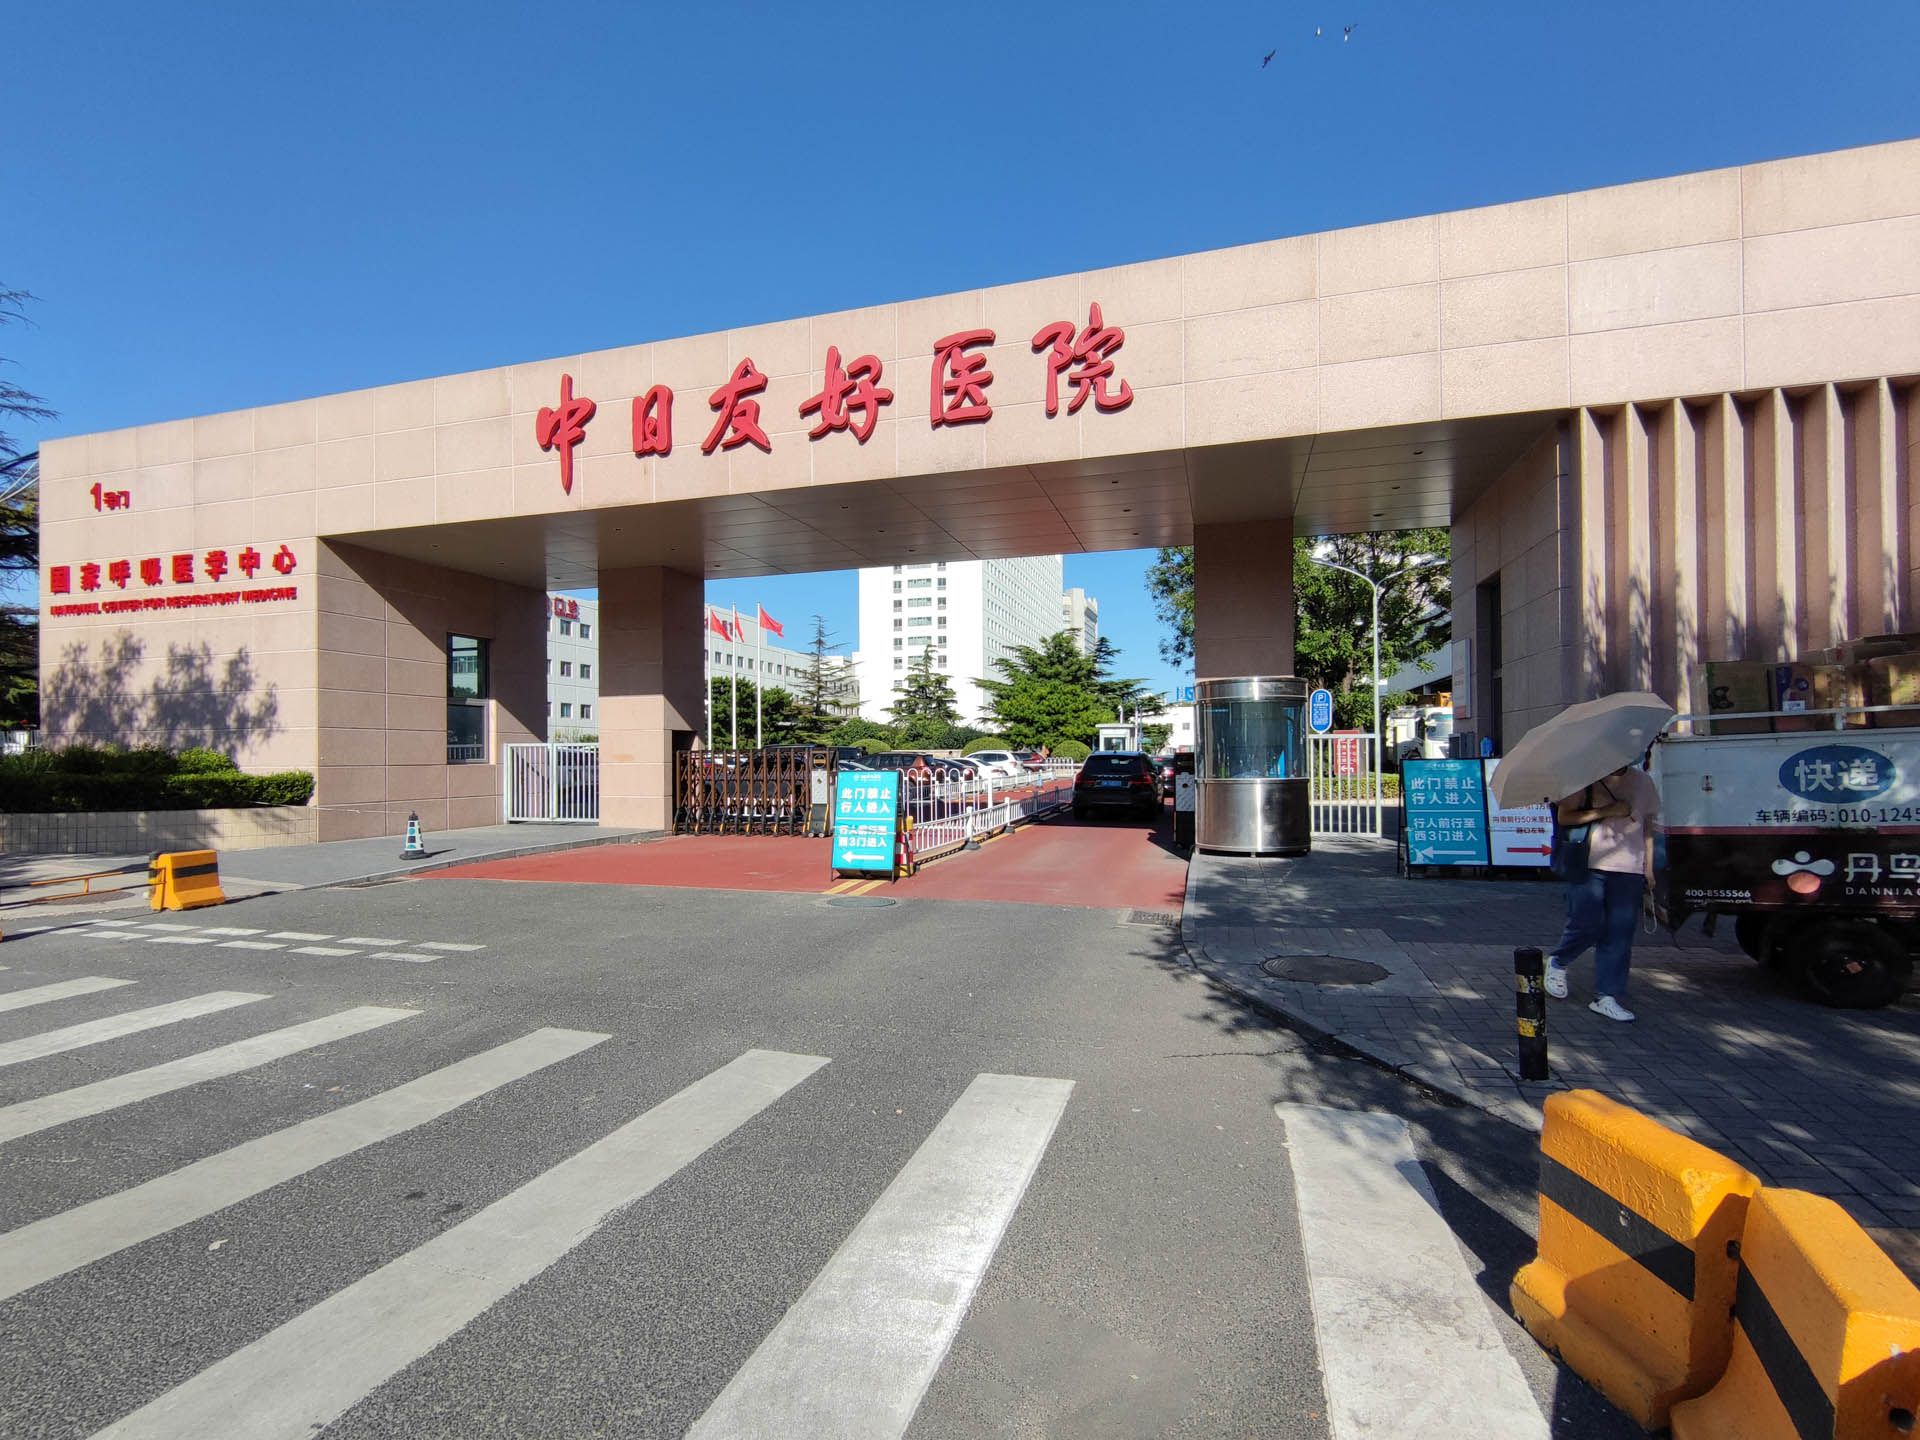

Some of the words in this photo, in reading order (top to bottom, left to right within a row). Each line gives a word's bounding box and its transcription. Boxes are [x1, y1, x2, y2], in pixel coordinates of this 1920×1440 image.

[536, 302, 1134, 495] 中日友好医院
[50, 544, 297, 595] 国家呼吸医学中心
[1411, 776, 1476, 791] 此门禁止
[1794, 758, 1881, 792] 快递
[1411, 792, 1477, 806] 行人进入
[1413, 817, 1477, 829] 行人前行至
[1414, 830, 1478, 842] 西3门进入
[1843, 853, 1920, 884] 丹鸟
